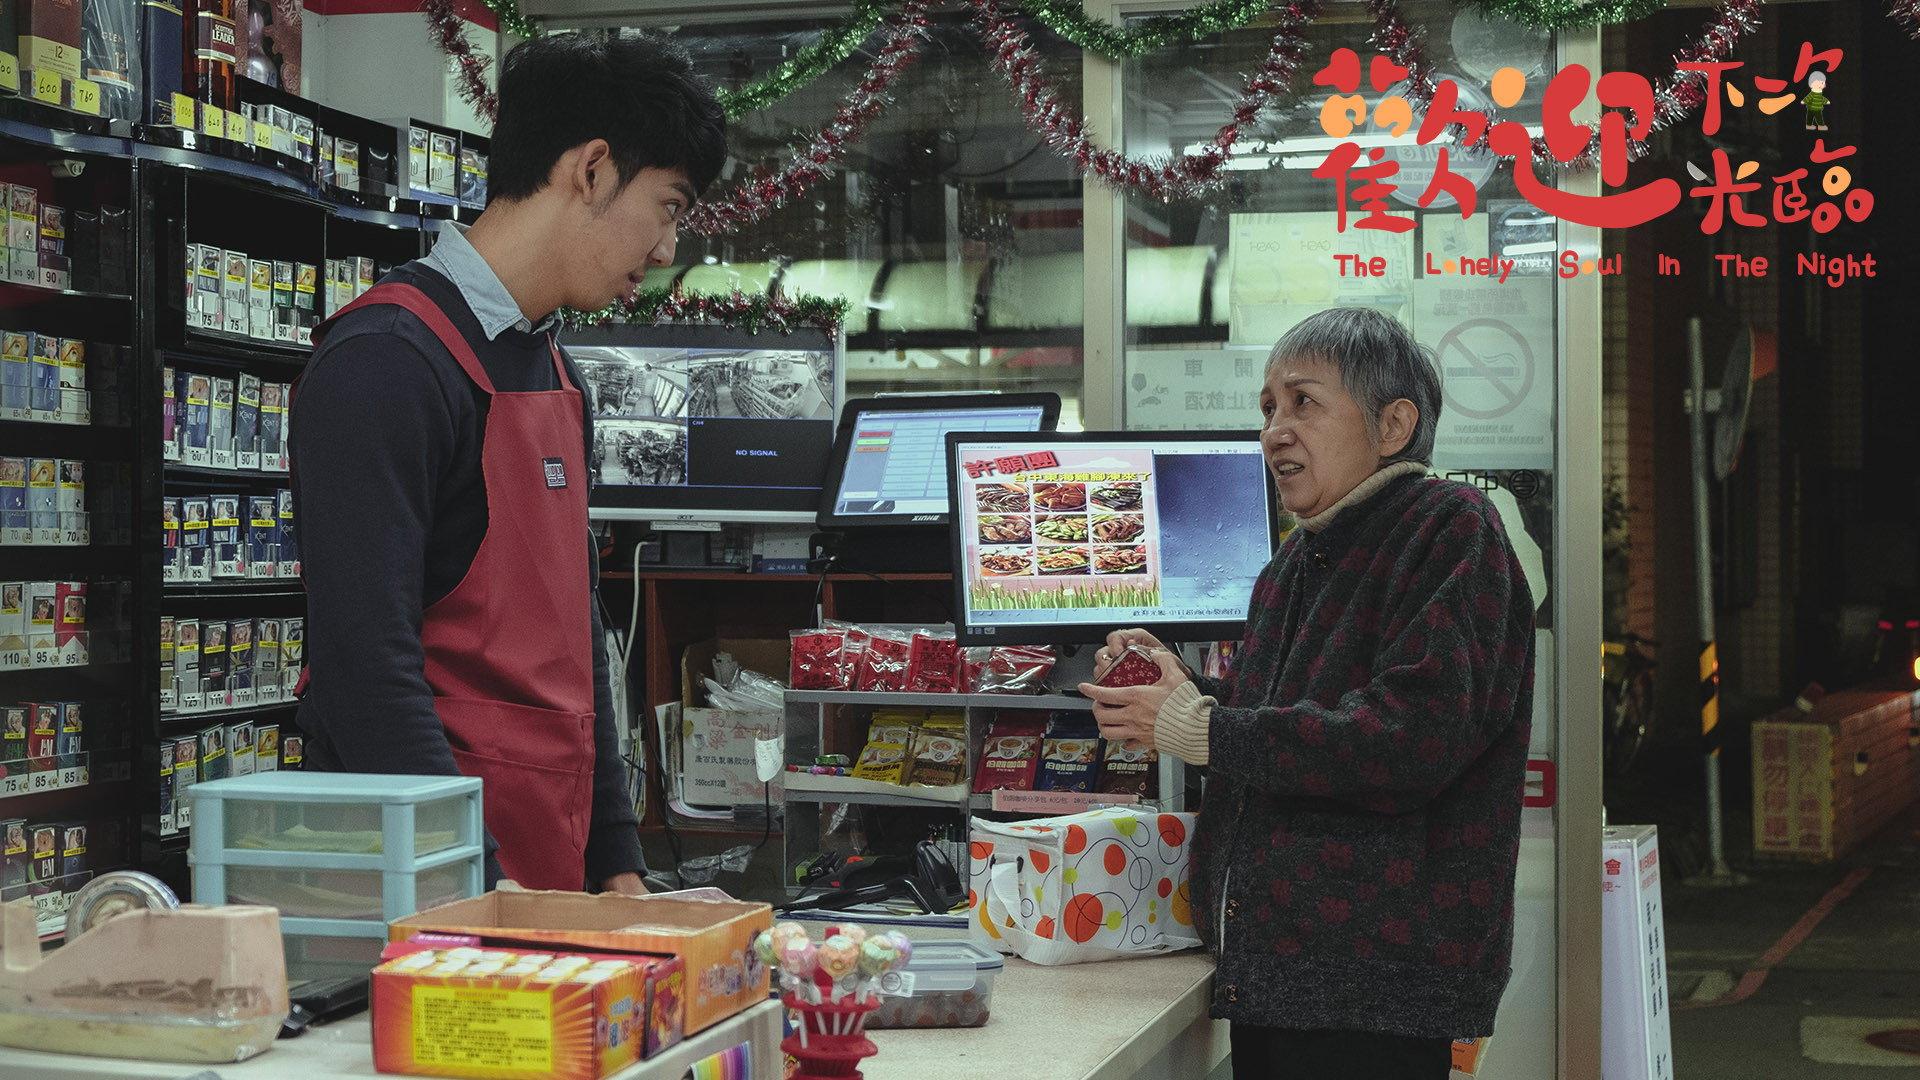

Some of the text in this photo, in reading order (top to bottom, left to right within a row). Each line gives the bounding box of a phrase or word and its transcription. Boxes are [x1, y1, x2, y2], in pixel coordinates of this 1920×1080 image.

[212, 29, 235, 46] LEADER
[54, 45, 63, 59] 12
[39, 78, 57, 94] 600
[46, 271, 57, 283] 90
[203, 314, 212, 326] 75
[230, 319, 239, 330] 75
[735, 449, 778, 457] NO SIGNAL
[67, 531, 76, 542] 70
[283, 565, 292, 575] 95
[4, 652, 20, 665] 110
[36, 651, 47, 663] 95
[66, 653, 76, 664] 95
[35, 775, 46, 788] 85
[64, 772, 75, 783] 85
[6, 780, 16, 792] 75
